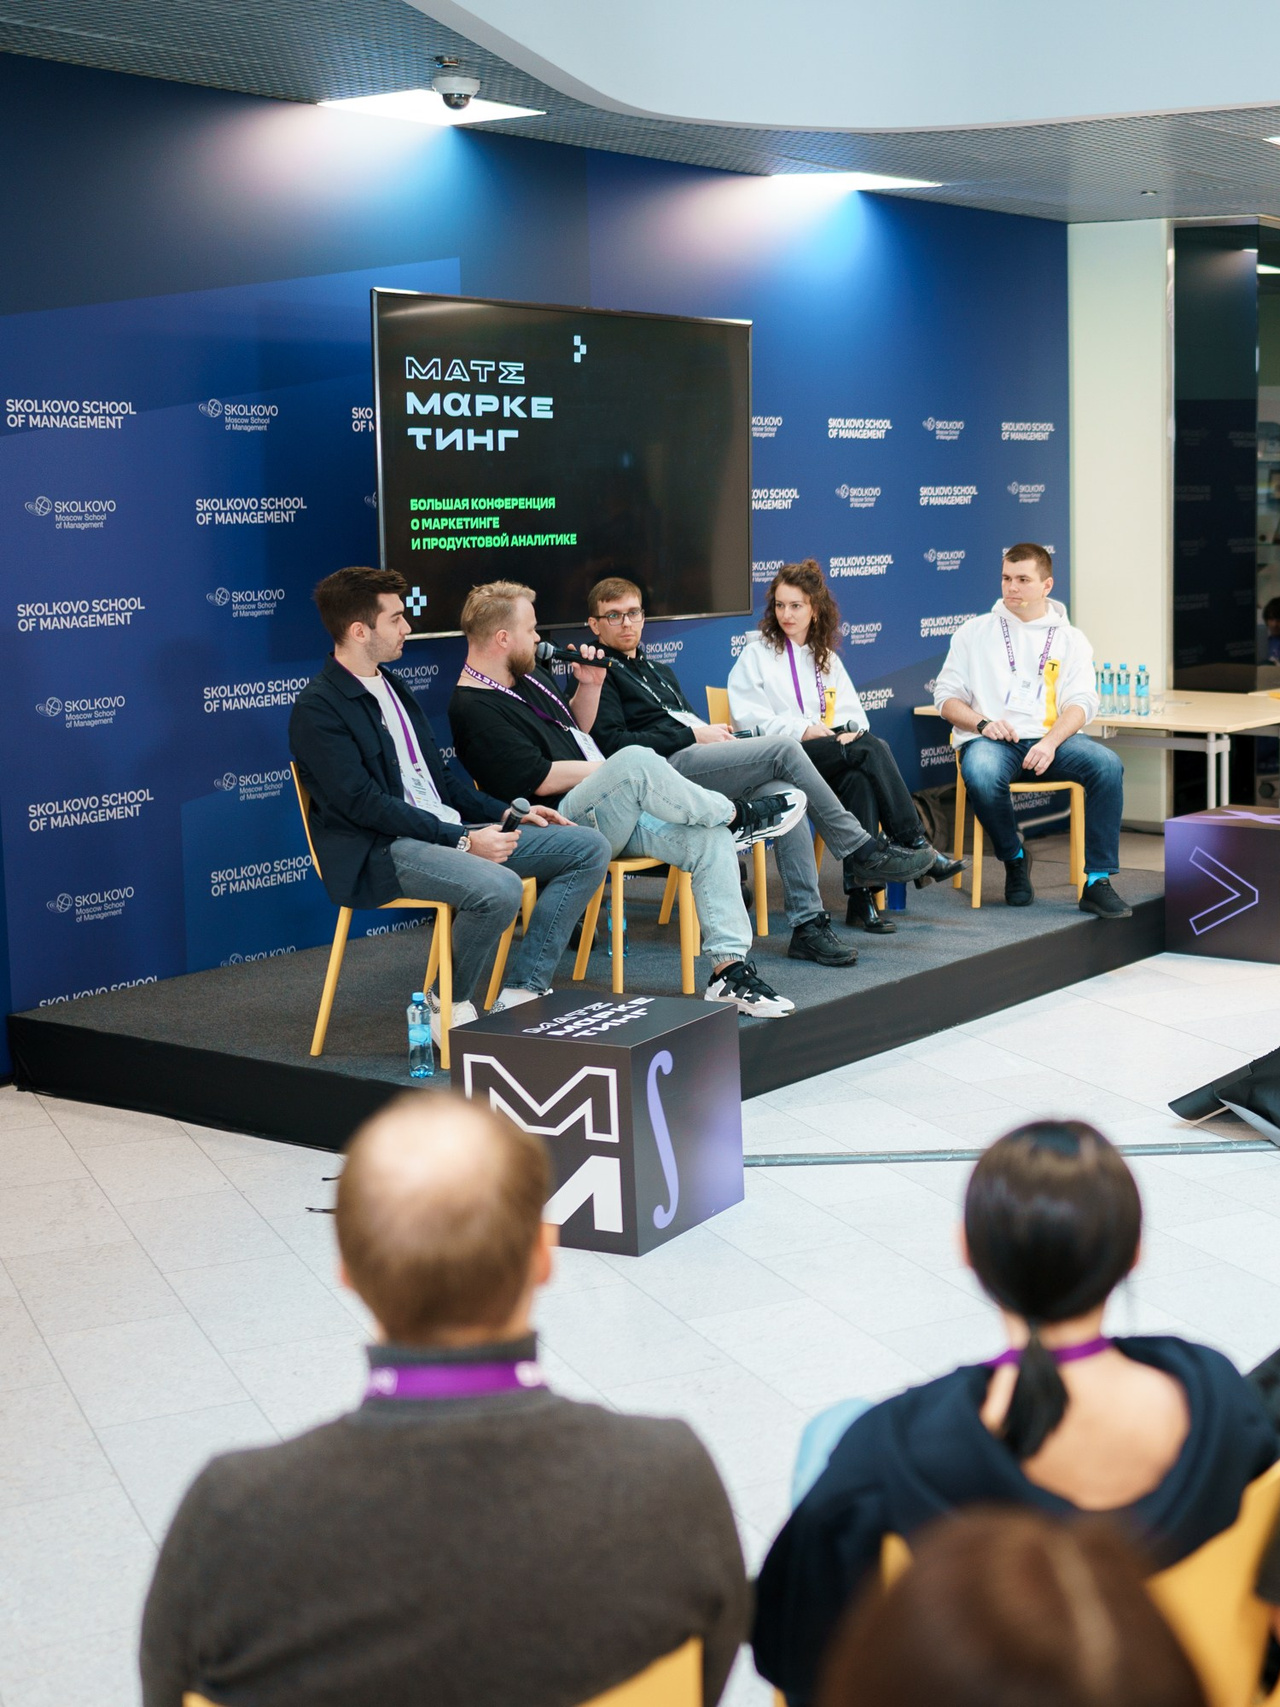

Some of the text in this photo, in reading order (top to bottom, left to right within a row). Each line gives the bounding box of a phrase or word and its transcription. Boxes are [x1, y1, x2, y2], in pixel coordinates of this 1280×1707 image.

[6, 398, 137, 415] SKOLKOVO SCHOOL
[224, 404, 279, 416] SKOLKOVO
[6, 414, 124, 429] OF MANAGEMENT
[225, 416, 249, 424] Moscow
[352, 420, 366, 432] OF
[752, 415, 783, 427] KOLKOVO
[828, 417, 893, 430] SKOLKOVO SCHOOL
[225, 423, 267, 432] of Management
[407, 427, 519, 451] ТИНГ
[828, 429, 886, 440] OF MANAGEMENT
[1001, 432, 1009, 441] OF
[769, 488, 799, 499] SCHOOL
[54, 500, 117, 513] SKOLKOVO
[195, 497, 307, 511] SKOLKOVO SCHOOL
[410, 497, 556, 511] БОЛЬШАЯ КОНФЕРЕНЦИЯ
[752, 499, 792, 510] NAGEMENT
[920, 496, 928, 506] OF
[55, 513, 107, 522] Moscow School
[196, 510, 296, 525] OF MANAGEMENT
[410, 517, 500, 531] О МАРКЕТИНГЕ
[55, 521, 104, 531] of Management
[411, 533, 577, 551] И ПРОДУКТОВОЙ АНАЛИТИКЕ
[830, 554, 894, 568] SKOLKOVO SCHOOL
[830, 565, 887, 578] OF MANAGEMENT
[231, 588, 285, 603] SKOLKOVO
[17, 597, 145, 617] SKOLKOVO SCHOOL
[232, 601, 277, 611] Moscow School
[232, 609, 274, 618] of Management
[18, 612, 133, 632] OF MANAGEMENT
[921, 628, 929, 638] OF
[646, 641, 683, 653] SKOLKOVO
[203, 681, 265, 700] SKOLKOVO
[866, 688, 894, 700] SCHOOL
[65, 695, 125, 712] SKOLKOVO
[204, 700, 220, 713] OF
[861, 698, 888, 711] GEMENT
[65, 709, 116, 721] Moscow School
[65, 717, 113, 728] of Management
[921, 753, 957, 767] OF MANAGE
[239, 769, 292, 787] SKOLKOVO
[239, 782, 283, 794] Moscow School
[239, 790, 280, 801] of Management
[28, 789, 154, 817] SKOLKOVO SCHOOL
[29, 804, 141, 832] OF MANAGEMENT
[211, 861, 271, 883] SKOLKOVO
[211, 868, 308, 897] OF MANAGEMENT
[75, 886, 134, 907] SKOLKOVO
[75, 900, 125, 915] Moscow School
[76, 909, 122, 923] of Management
